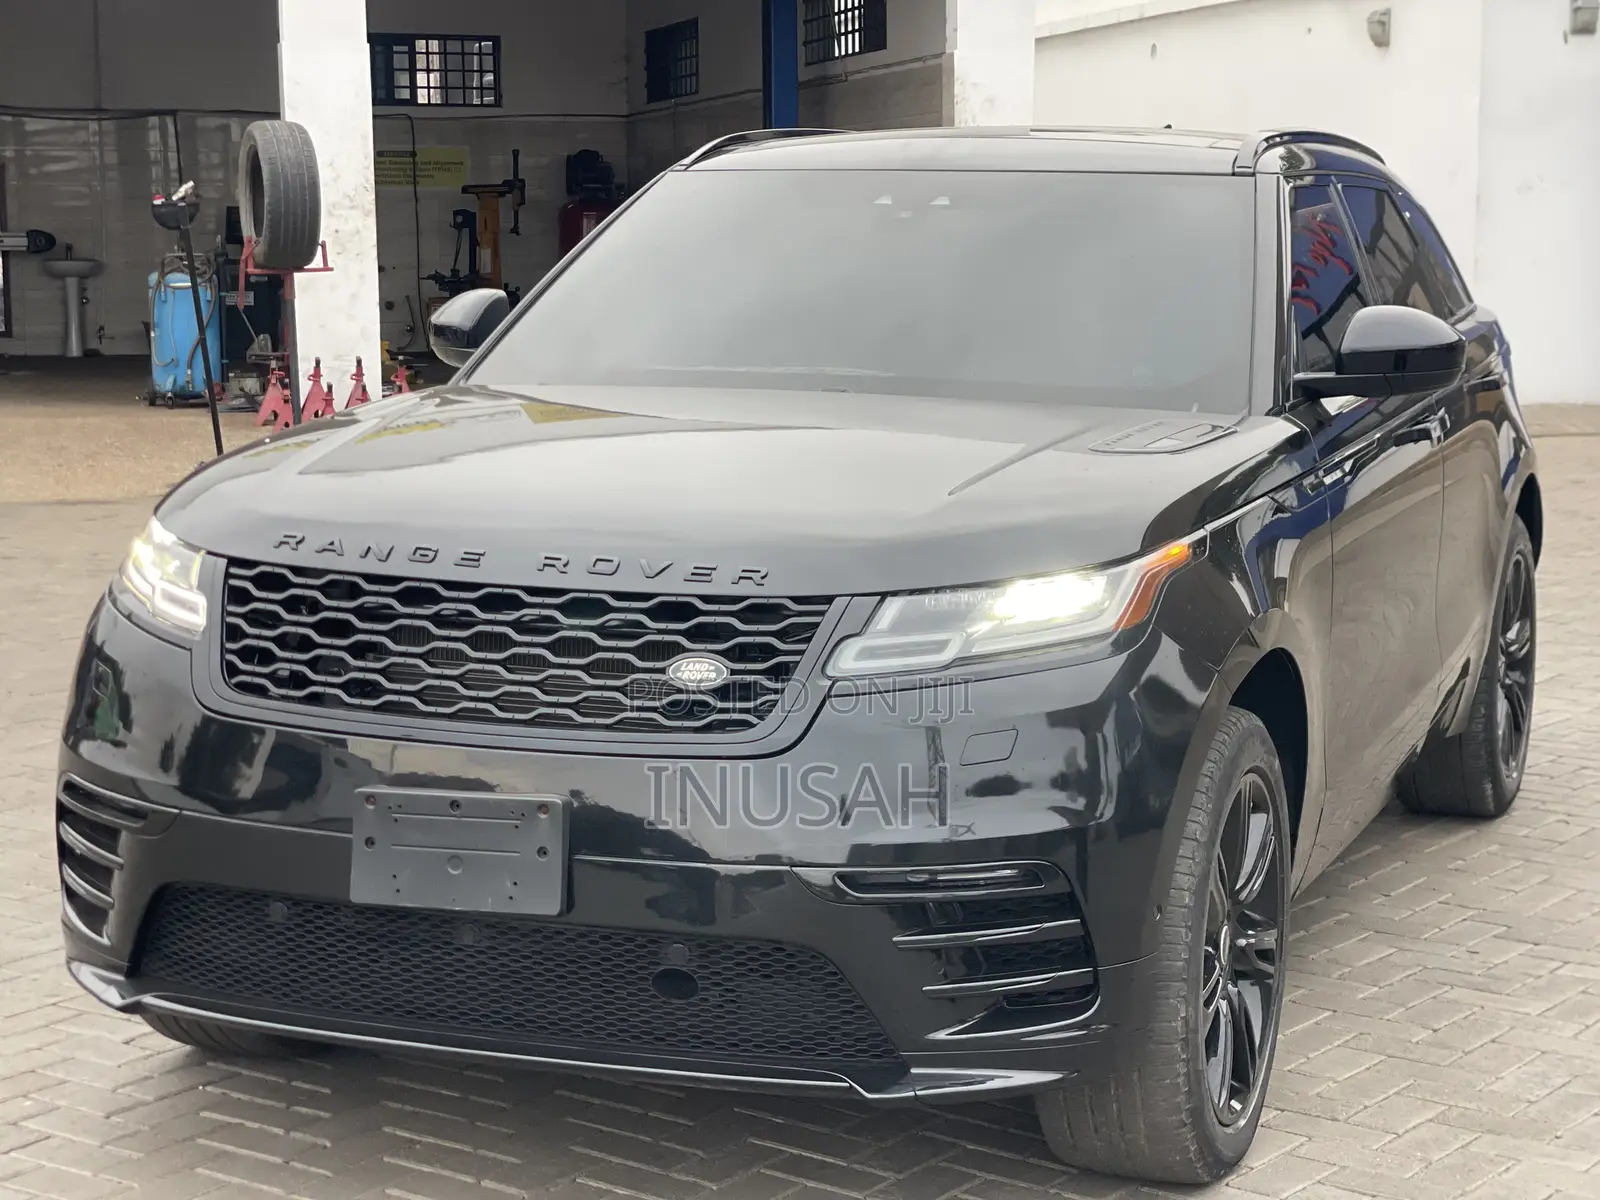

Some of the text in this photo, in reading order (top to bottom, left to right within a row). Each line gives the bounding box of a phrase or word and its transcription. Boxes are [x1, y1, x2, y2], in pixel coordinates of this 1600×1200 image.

[273, 531, 770, 587] RANGE ROVER
[680, 662, 709, 671] LAND
[681, 670, 717, 681] ROVER
